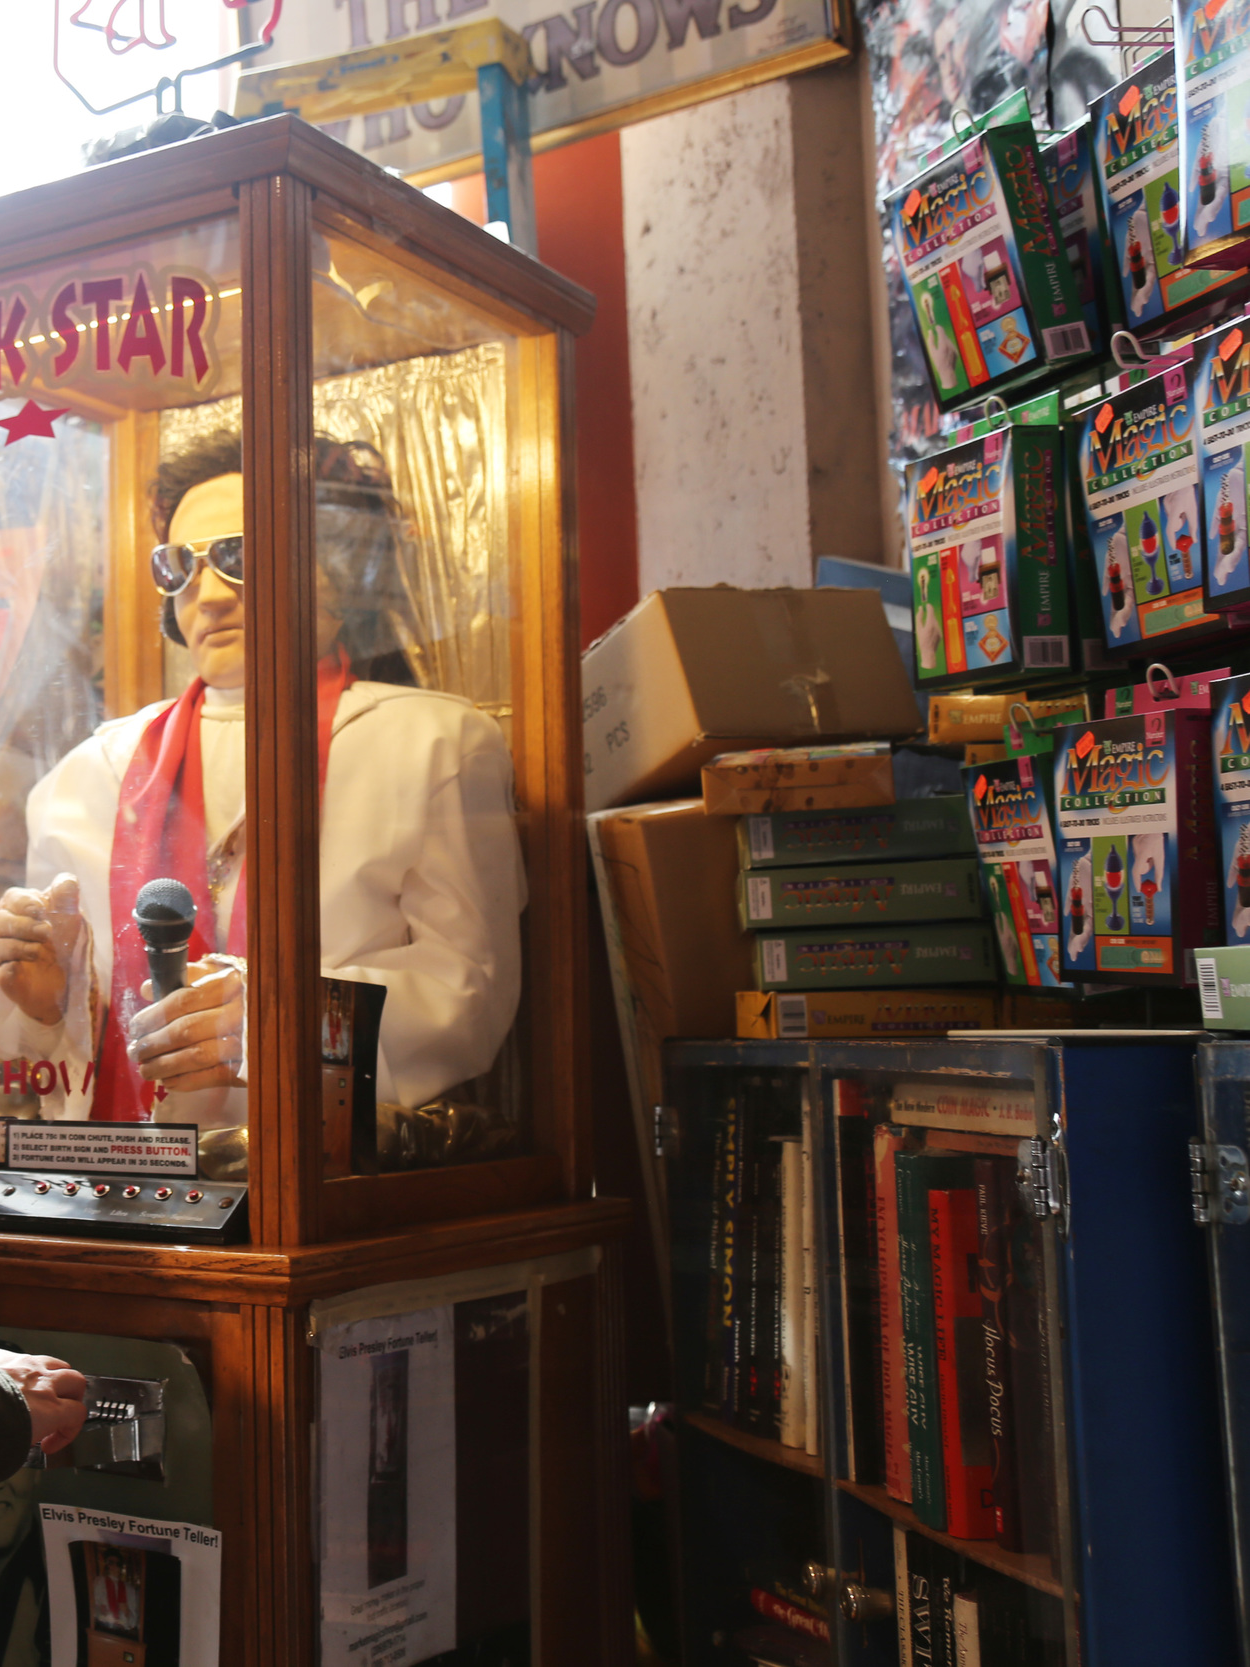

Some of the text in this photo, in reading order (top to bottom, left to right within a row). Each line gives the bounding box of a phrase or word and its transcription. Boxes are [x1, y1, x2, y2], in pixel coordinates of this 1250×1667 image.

[1153, 75, 1177, 96] EMPIR
[1105, 86, 1178, 166] Mag
[1110, 126, 1178, 174] COLLECT
[900, 171, 995, 253] Magic
[1006, 145, 1051, 256] Magic
[907, 207, 993, 263] COLLECTION
[52, 272, 210, 385] STAR
[1133, 405, 1157, 422] EMPIRE
[1087, 404, 1195, 480] Magic
[1091, 444, 1188, 491] COLLECTION
[911, 462, 1006, 530] Magic
[914, 502, 999, 536] COLLECTION
[1037, 570, 1052, 613] EMPIRE
[606, 721, 630, 753] PCS
[961, 712, 1003, 726] EMPIRE
[1112, 741, 1136, 754] EMPIRE
[1061, 743, 1170, 813] Magic
[972, 785, 1042, 846] Magic
[1064, 791, 1162, 808] COLLECTION
[979, 827, 1040, 842] COLLECTION
[779, 880, 942, 912] EMPIRE Magic
[795, 942, 958, 976] EMPIRE Magic
[827, 1014, 866, 1025] EMPIRE
[936, 1095, 958, 1116] COIN
[960, 1096, 990, 1118] MAGIC
[21, 1132, 43, 1141] PLACE
[68, 1133, 86, 1141] COIN
[87, 1134, 114, 1143] CHUTE,
[115, 1135, 136, 1143] PUSH
[138, 1136, 153, 1144] AND
[155, 1136, 191, 1145] RELEASE.
[21, 1144, 49, 1152] SELECT
[50, 1145, 72, 1153] BIRTH
[73, 1146, 91, 1154] SIGN
[110, 1145, 143, 1156] PRESS
[146, 1146, 192, 1157] BUTTON.
[21, 1154, 54, 1162] FORTUNE
[96, 1157, 128, 1166] APPEAR
[128, 1158, 137, 1166] IN
[139, 1158, 148, 1166] 30
[149, 1159, 189, 1168] SECONDS.
[722, 1097, 737, 1328] SIMPLY SIMON
[978, 1184, 987, 1207] PAUL
[931, 1208, 940, 1238] MY
[980, 1208, 989, 1235] KIEVE
[710, 1219, 720, 1269] Michael
[932, 1243, 945, 1303] MAGIC
[338, 1345, 357, 1359] Elvis
[359, 1341, 386, 1354] Presley
[388, 1337, 414, 1349] Fortune
[935, 1306, 947, 1361] LIFE
[907, 1342, 917, 1385] WISE
[881, 1335, 894, 1459] OF DOVE MAGIC
[910, 1388, 919, 1426] GUY
[42, 1508, 219, 1548] Elvis Presley Fortune Teller!
[959, 1623, 968, 1641] The
